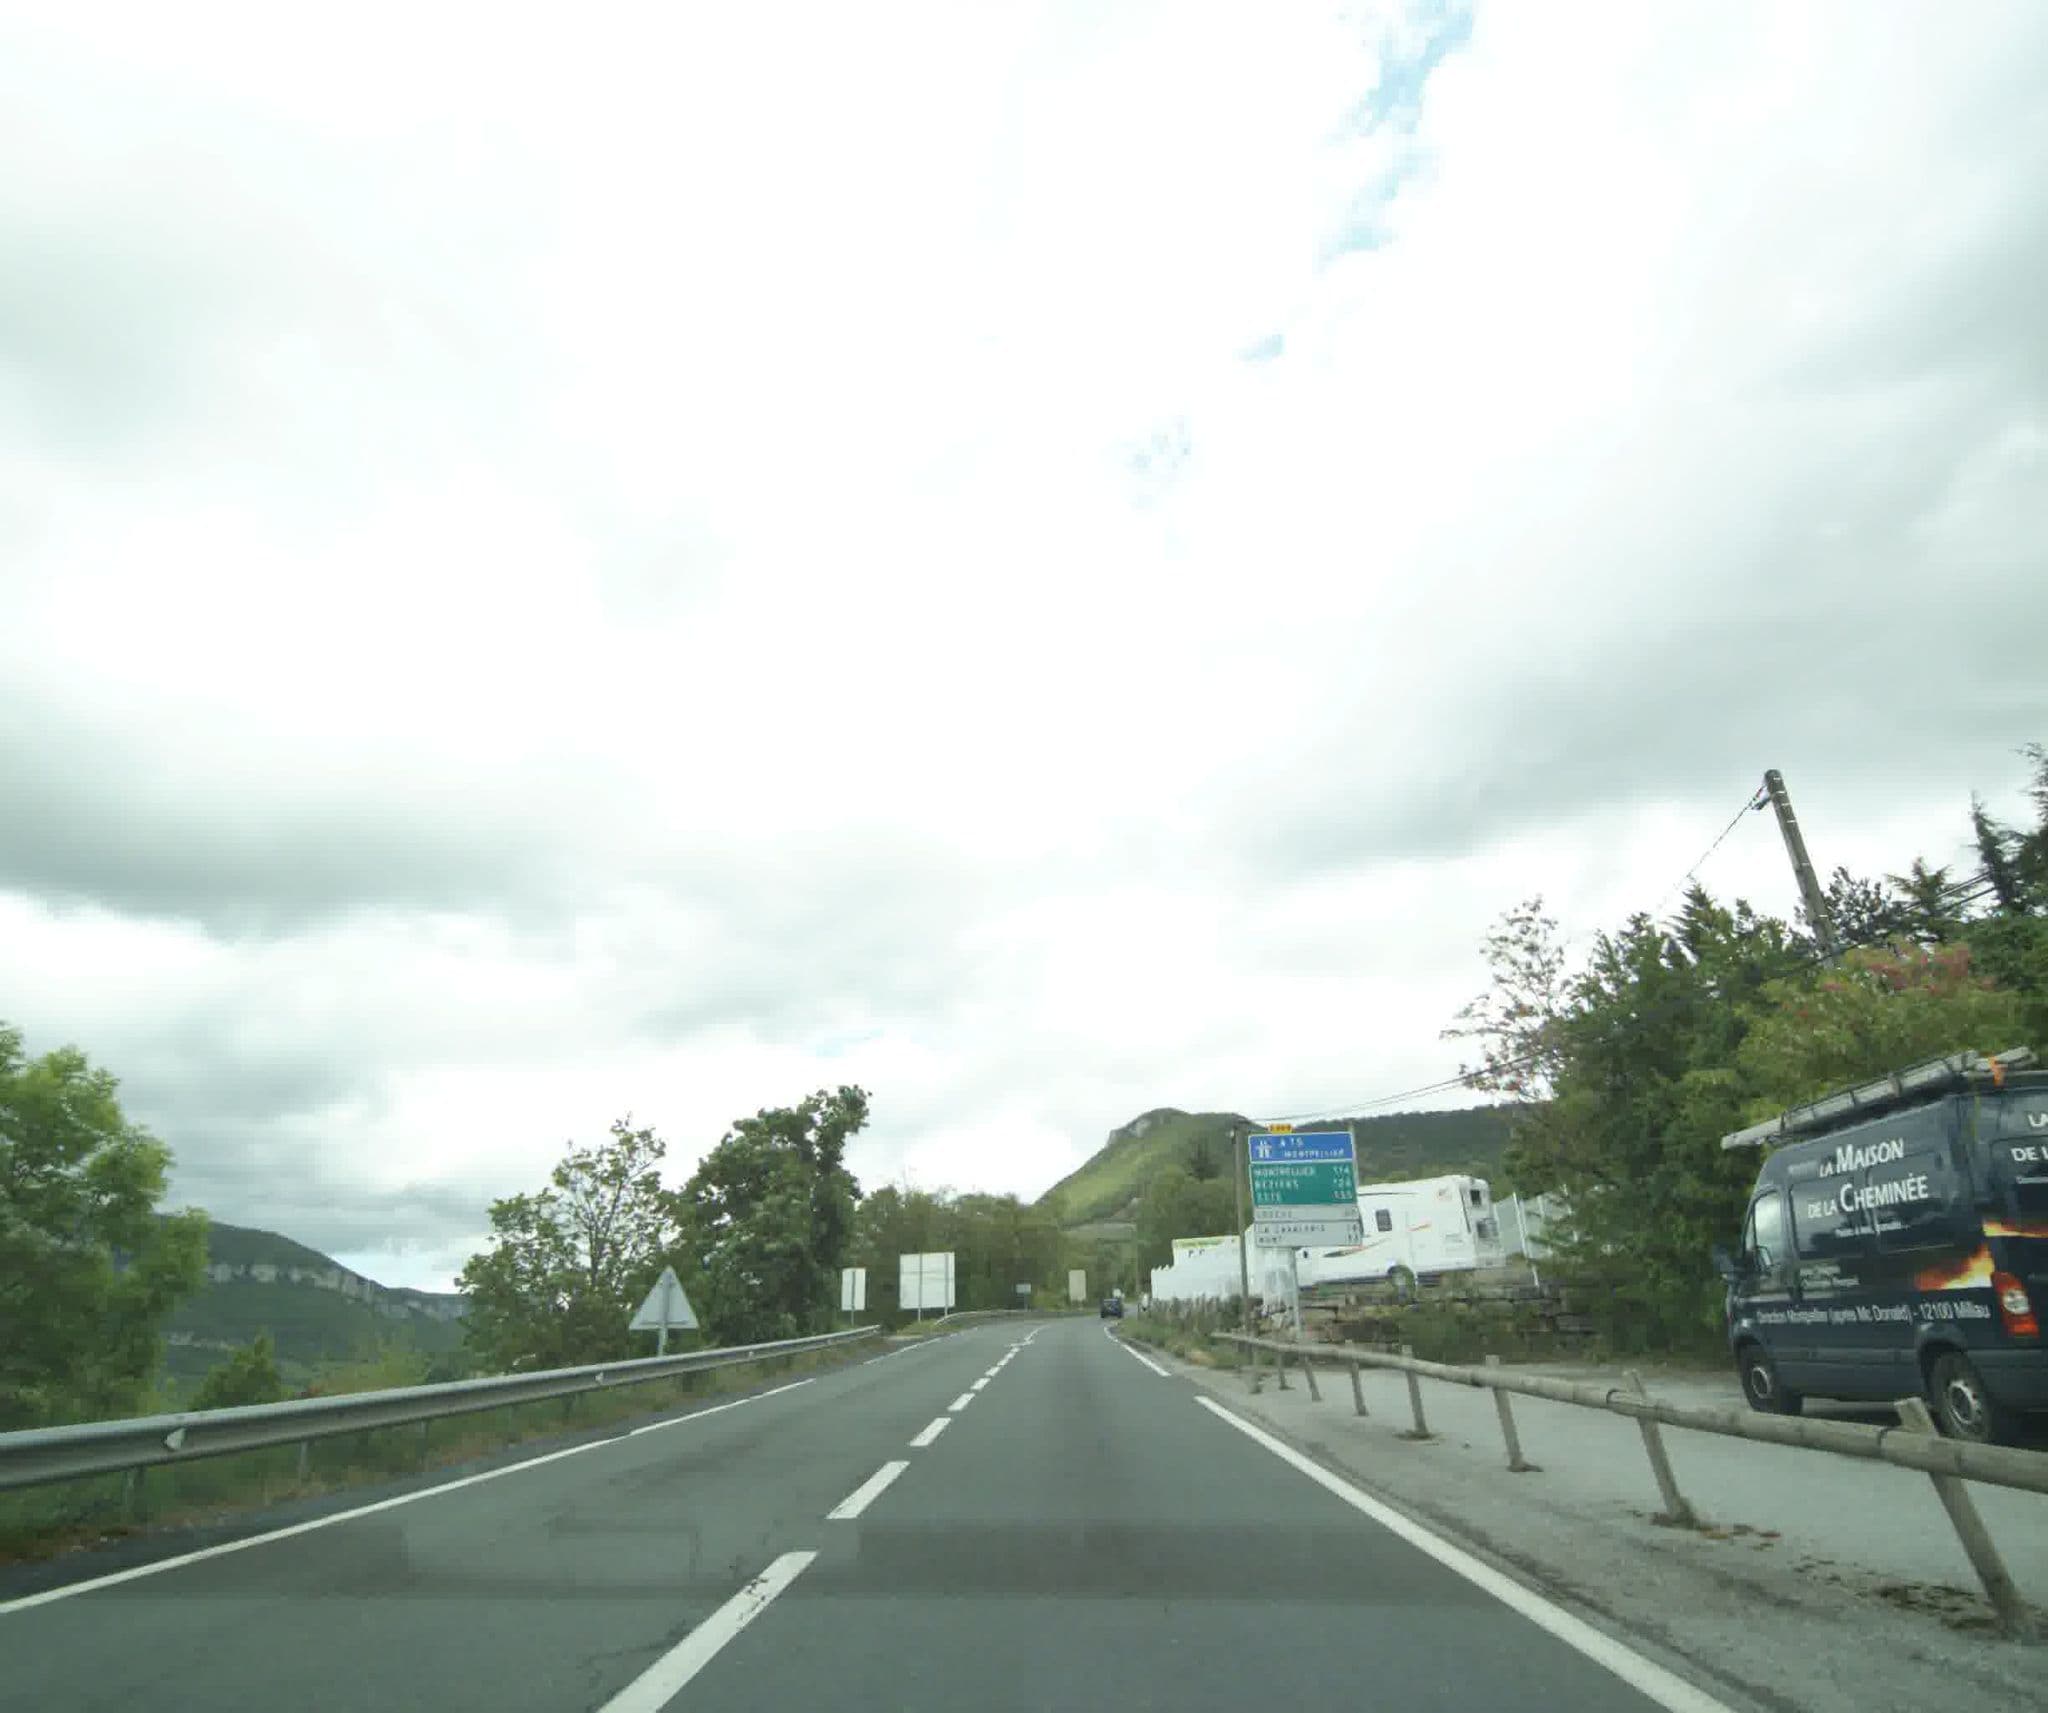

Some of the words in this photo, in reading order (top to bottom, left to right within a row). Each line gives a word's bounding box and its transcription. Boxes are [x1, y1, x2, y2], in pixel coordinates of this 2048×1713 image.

[2011, 1147, 2039, 1161] DE
[1820, 1161, 1833, 1178] LA
[1808, 1202, 1822, 1218] DE
[1823, 1198, 1837, 1216] LA
[1840, 1173, 1929, 1212] CHEMINÉE
